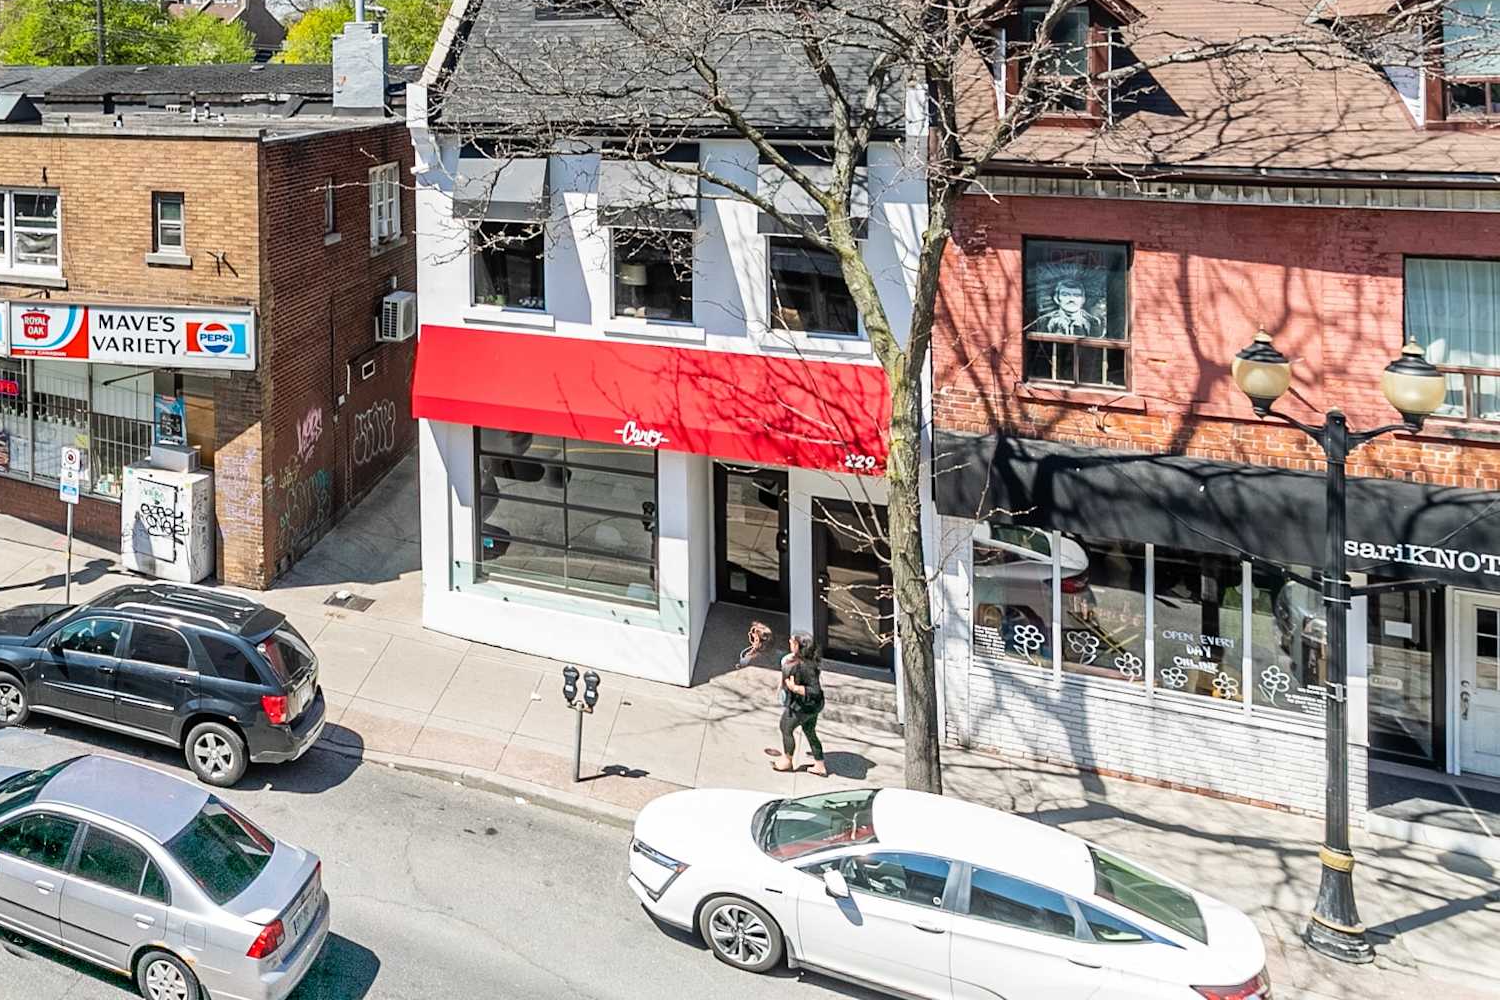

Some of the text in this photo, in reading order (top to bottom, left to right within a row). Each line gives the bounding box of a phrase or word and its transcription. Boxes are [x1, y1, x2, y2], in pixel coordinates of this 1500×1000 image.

[23, 316, 48, 325] ROYAL
[98, 314, 176, 334] MAVE'S
[27, 326, 45, 337] OAK
[200, 333, 233, 343] PEPSI
[92, 335, 181, 356] VARIETY
[845, 453, 876, 469] 229
[1162, 629, 1193, 642] OPEN
[1186, 643, 1211, 658] DAY
[1173, 655, 1219, 673] ONLINE
